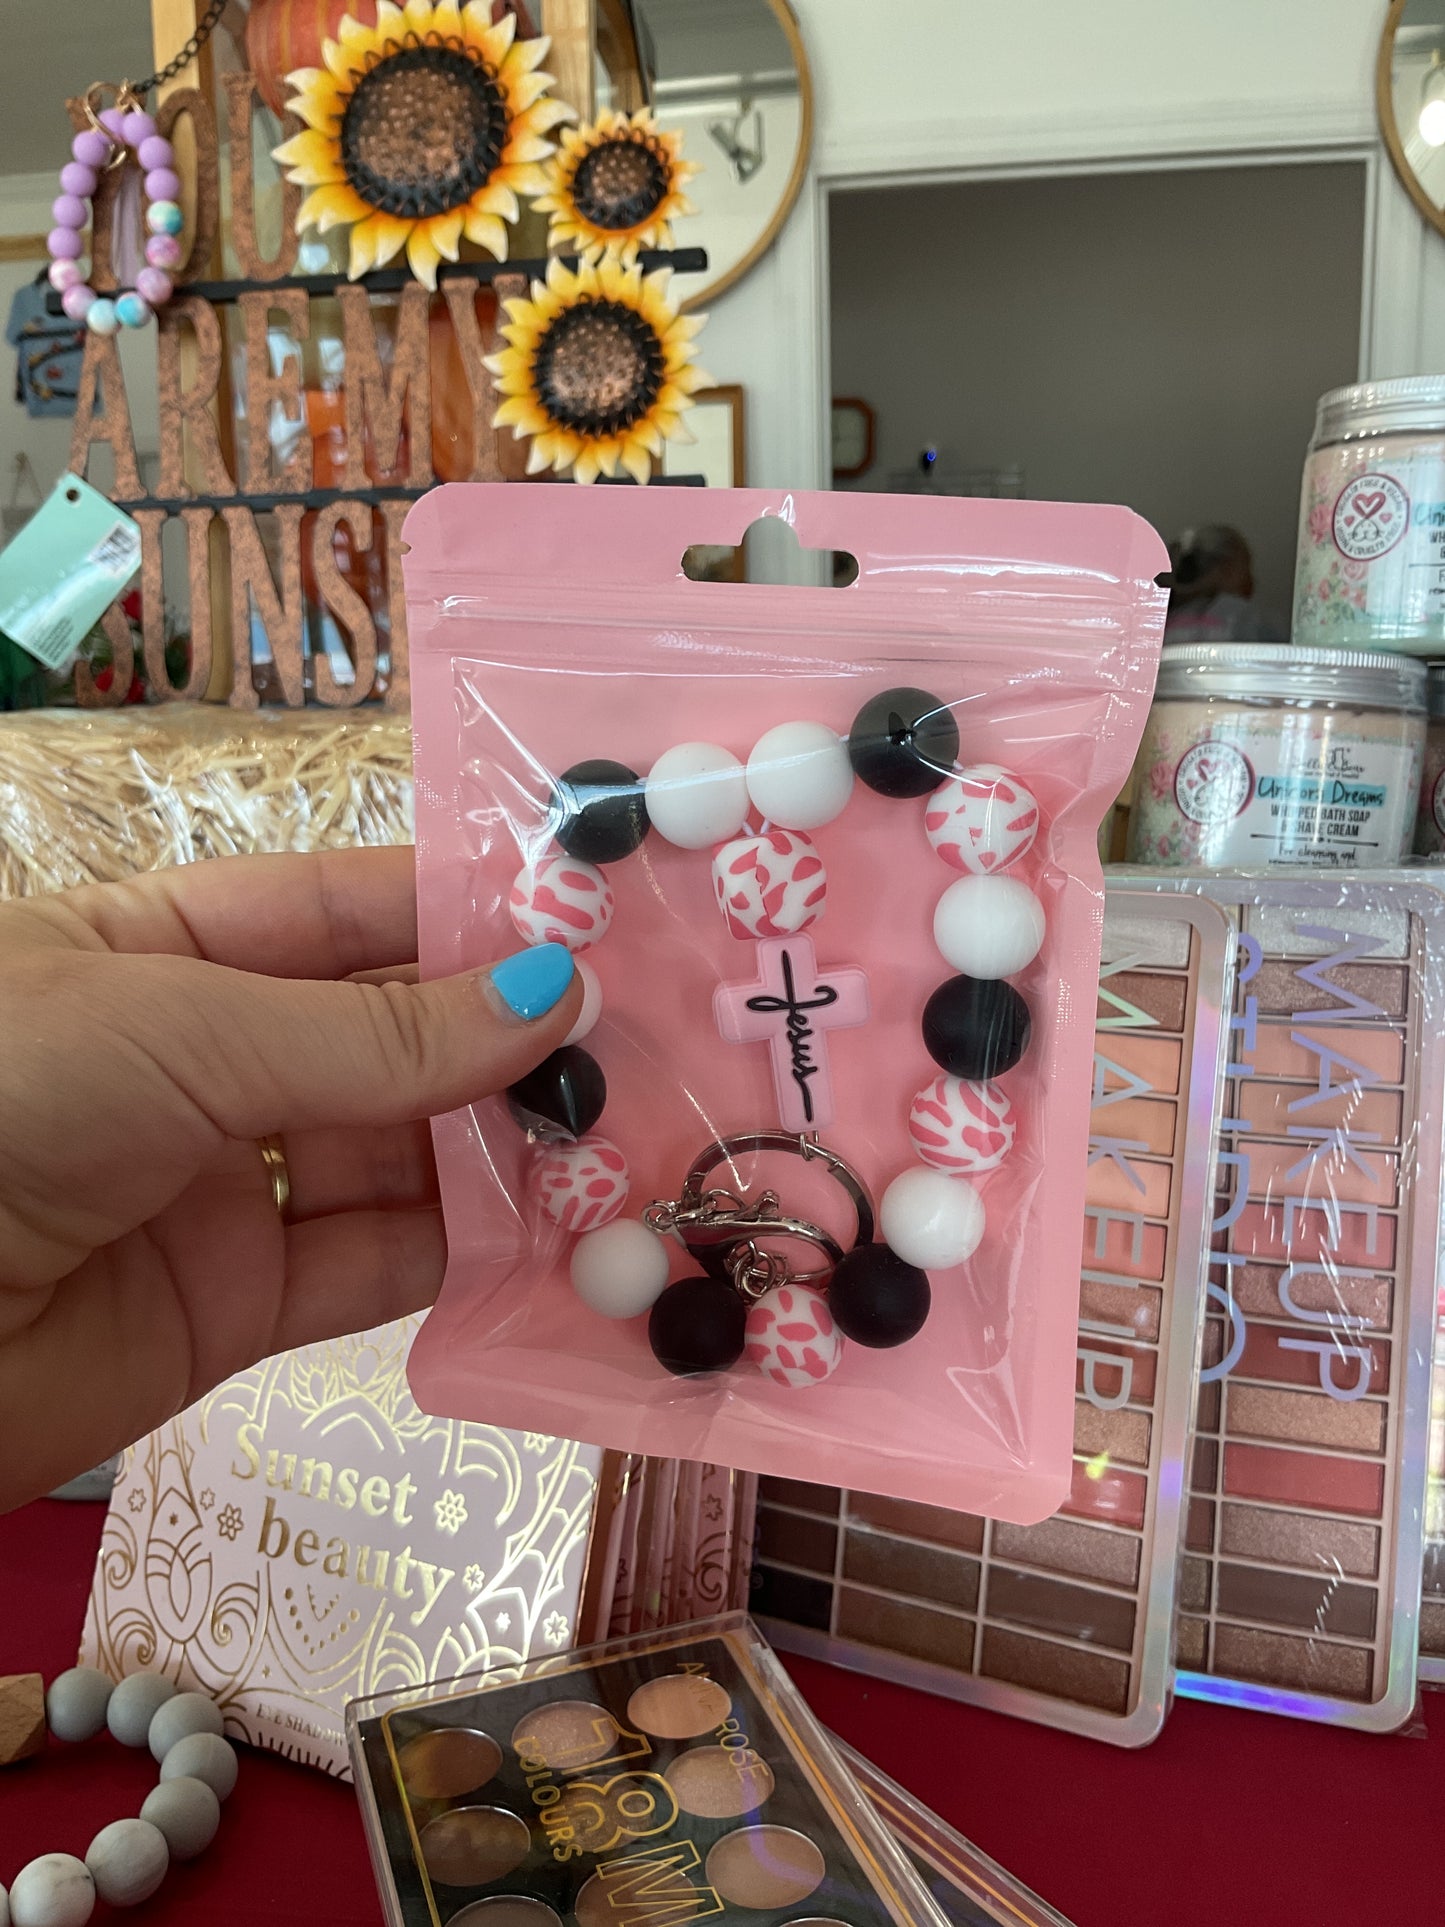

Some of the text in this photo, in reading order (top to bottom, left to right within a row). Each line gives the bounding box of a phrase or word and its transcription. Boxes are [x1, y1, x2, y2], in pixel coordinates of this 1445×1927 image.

[70, 273, 527, 501] ARE MY
[1271, 804, 1317, 820] WHPED
[1348, 810, 1371, 823] SOAP
[1327, 823, 1359, 837] CREAM
[1331, 780, 1384, 807] Dreams
[747, 950, 837, 1122] Jesus
[1278, 925, 1389, 1399] MAKEUP
[231, 1423, 418, 1527] Sunset
[257, 1496, 455, 1627] beauty
[513, 1736, 584, 1863] COLOURS
[715, 1718, 769, 1783] ROSE
